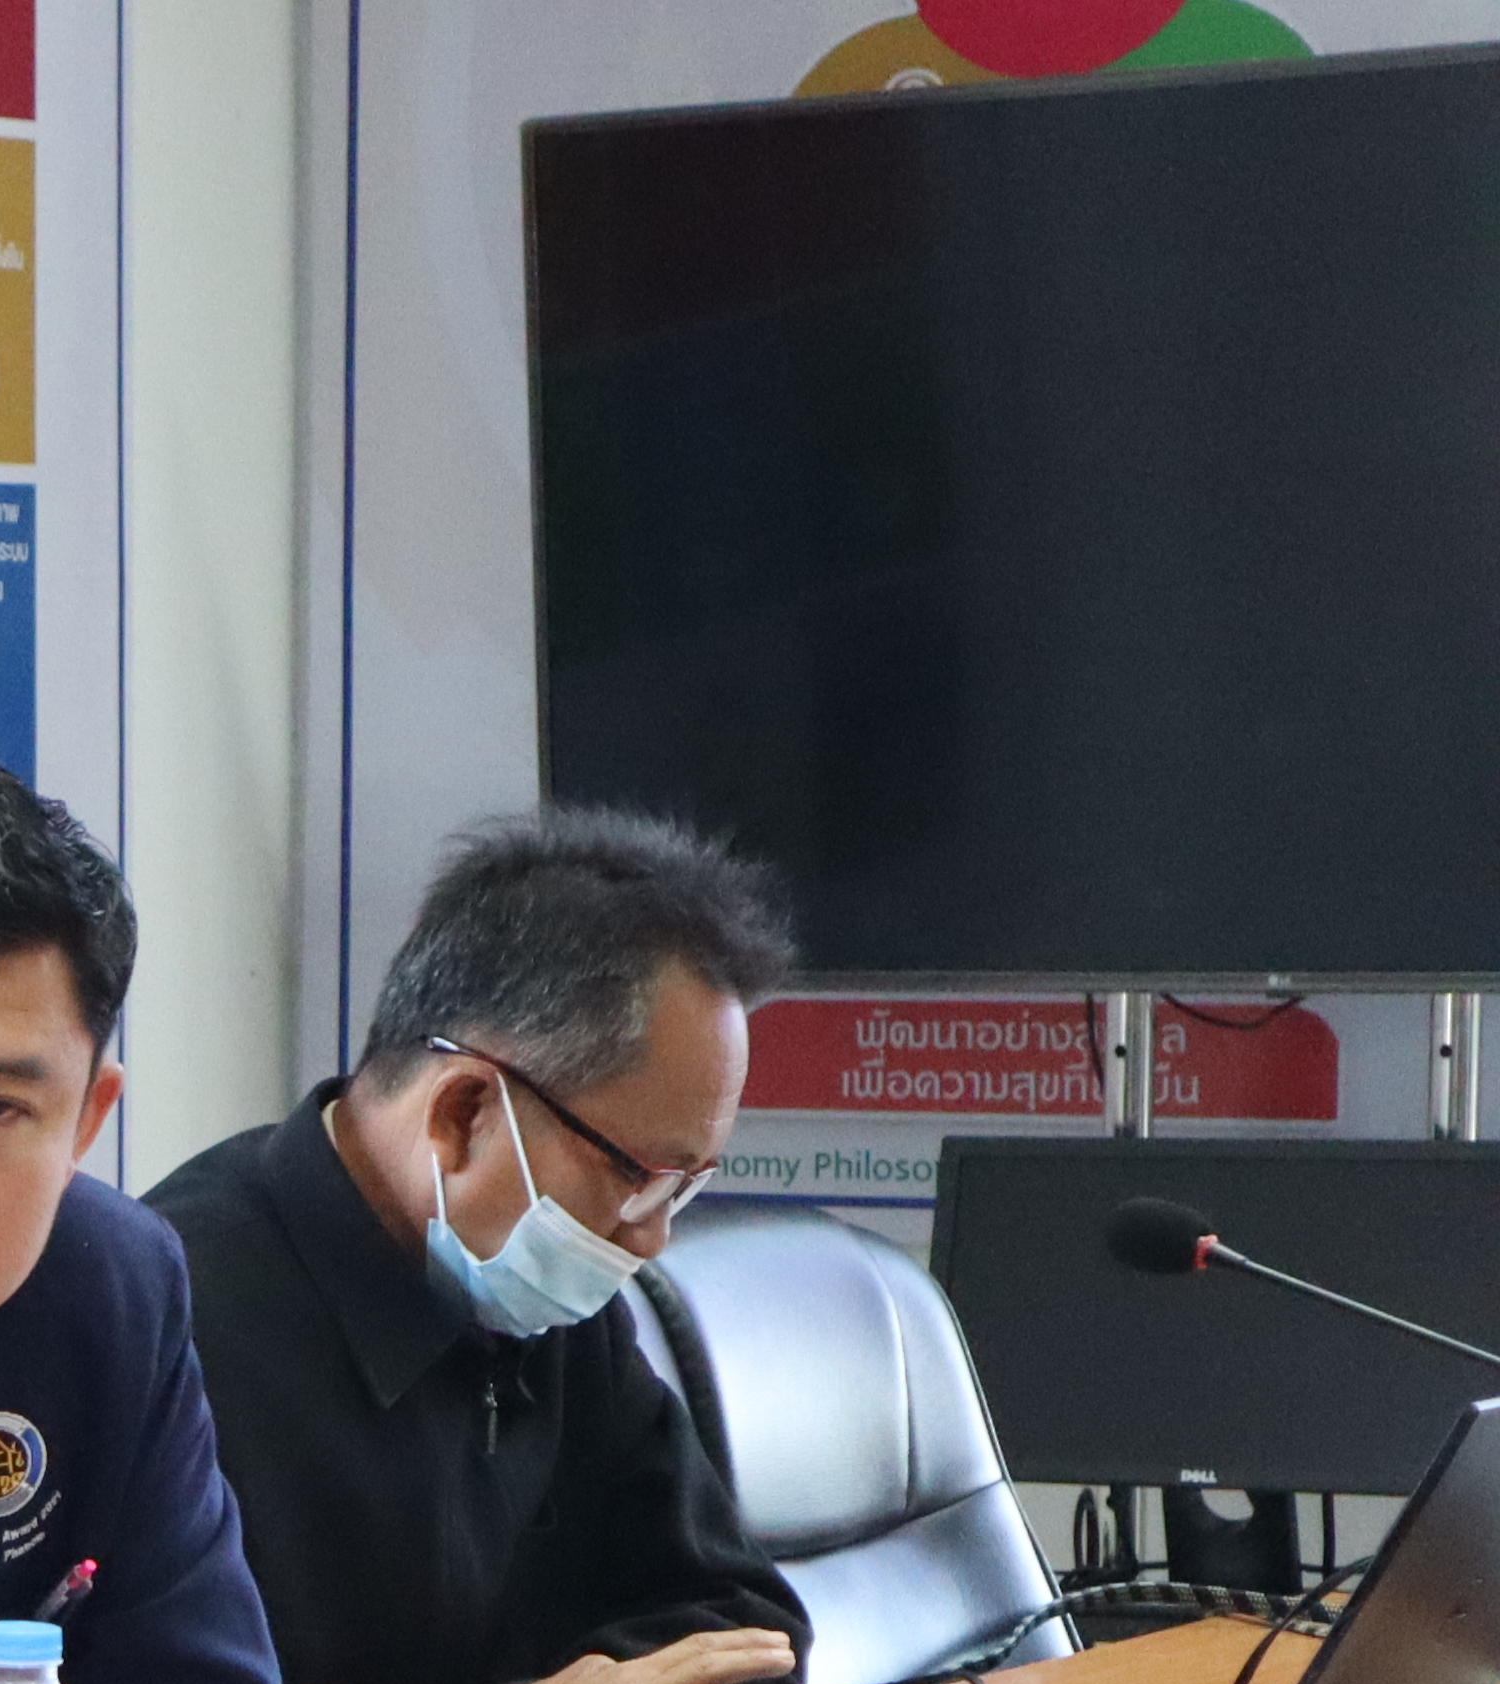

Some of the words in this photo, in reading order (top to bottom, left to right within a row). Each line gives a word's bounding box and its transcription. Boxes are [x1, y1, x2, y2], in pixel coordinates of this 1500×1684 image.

[814, 1149, 938, 1183] Philoso
[1180, 1467, 1218, 1485] DELL
[2, 1516, 39, 1543] Award
